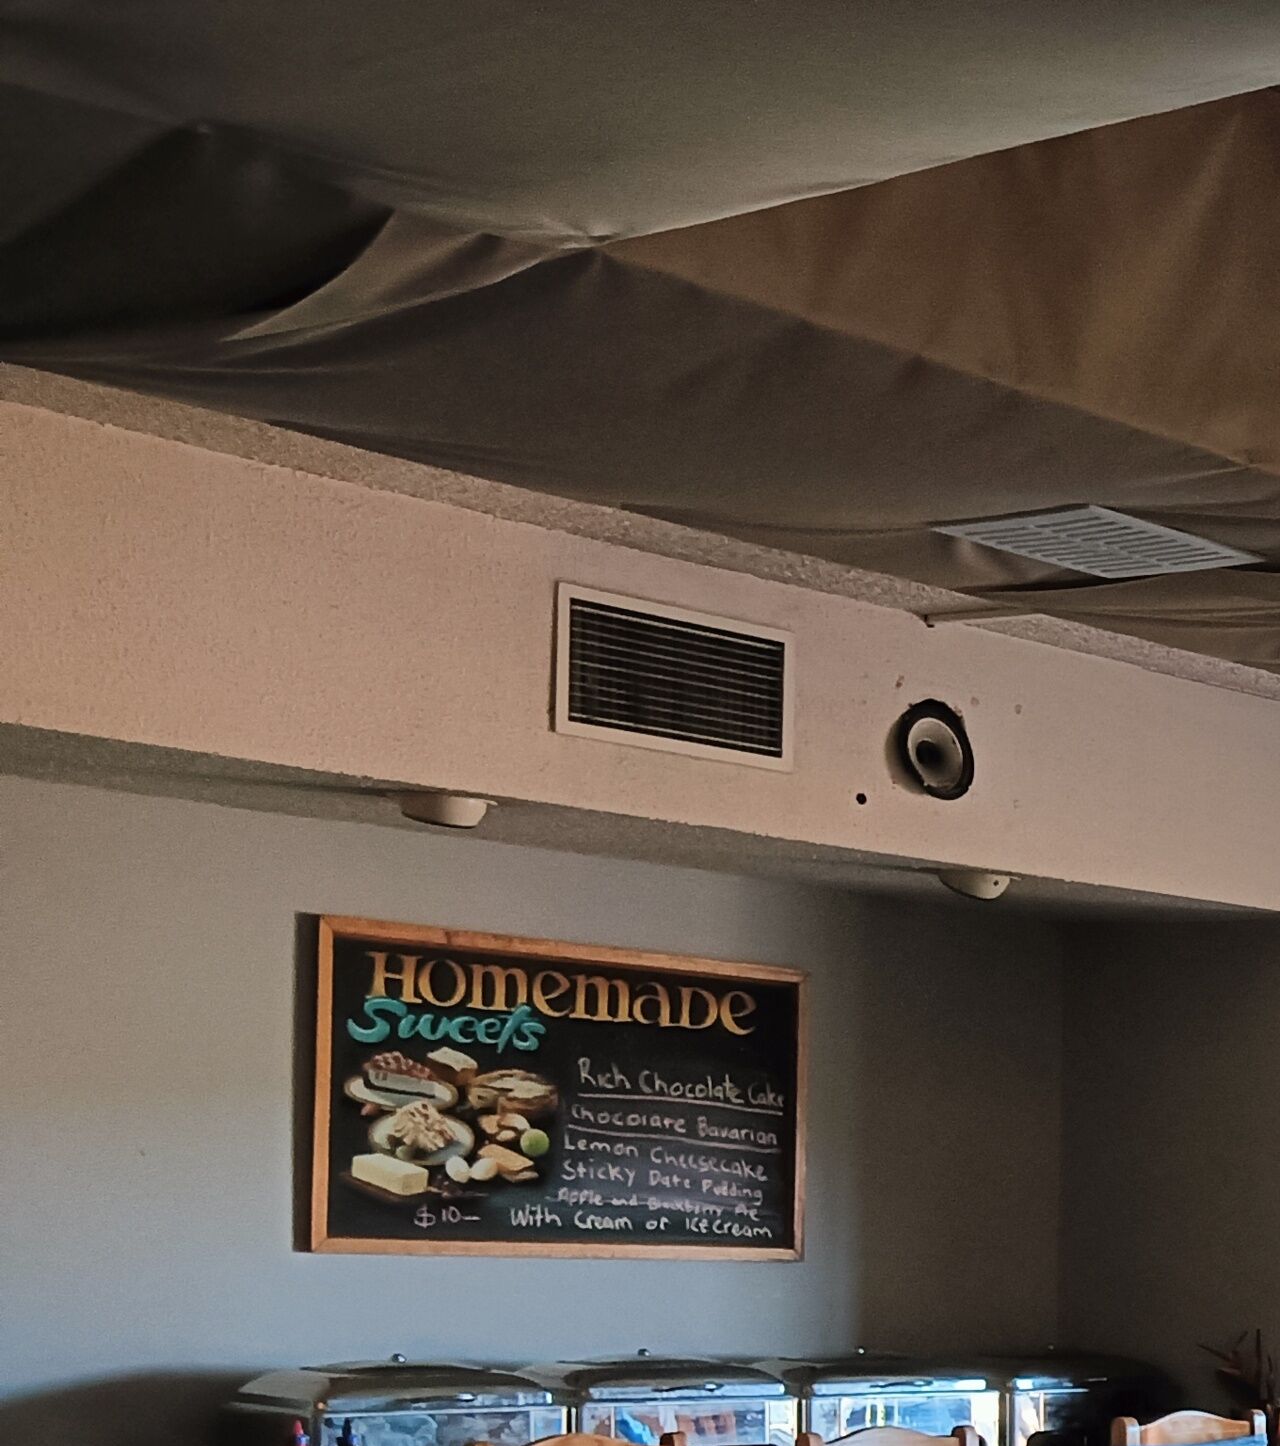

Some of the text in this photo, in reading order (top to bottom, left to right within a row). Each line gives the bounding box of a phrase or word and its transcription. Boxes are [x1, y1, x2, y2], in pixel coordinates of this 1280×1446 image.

[347, 996, 546, 1054] Sweets
[577, 1057, 632, 1089] Rich
[638, 1070, 745, 1104] Chocolate
[697, 1116, 777, 1146] Bavarian
[561, 1157, 763, 1206] Sticky Date Pudding
[564, 1133, 768, 1182] Lemon Cheesecake
[510, 1204, 562, 1228] With
[574, 1210, 633, 1231] Cream
[645, 1216, 670, 1231] or
